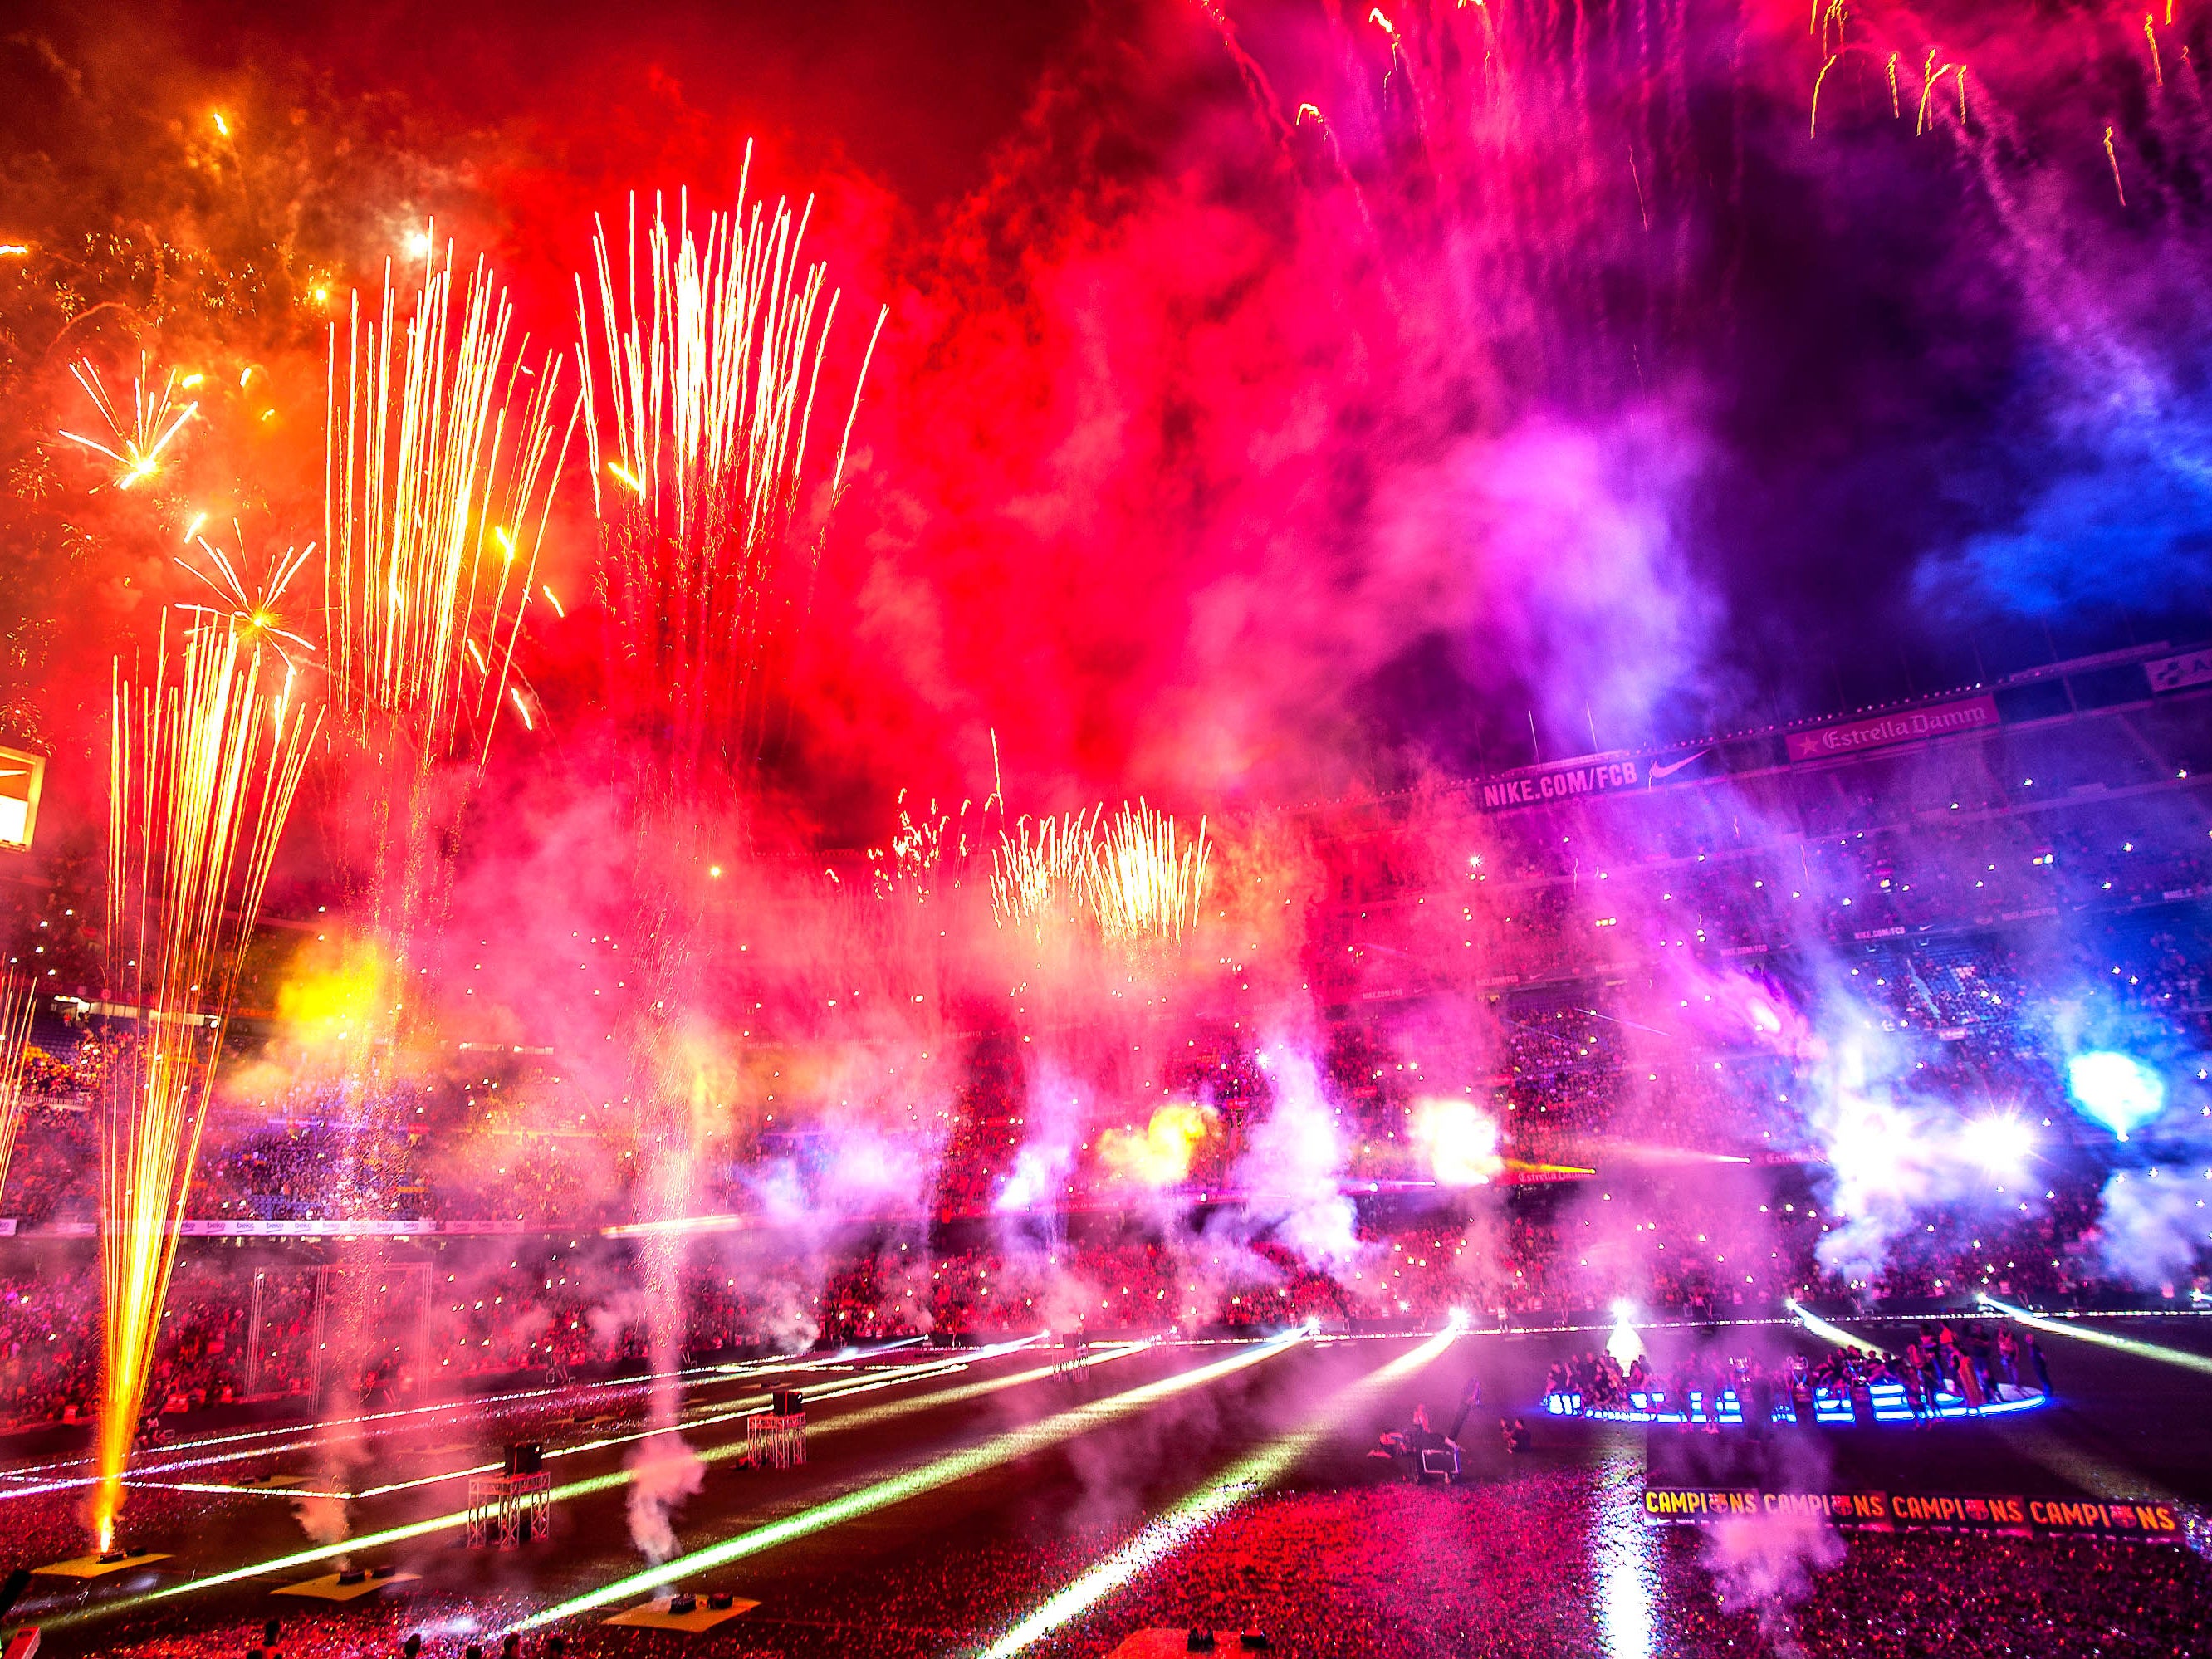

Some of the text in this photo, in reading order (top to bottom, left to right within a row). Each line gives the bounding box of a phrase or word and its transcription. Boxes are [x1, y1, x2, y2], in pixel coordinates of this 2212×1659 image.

[1822, 706, 1989, 750] Estrella Damm
[1484, 762, 1639, 807] NIKE.COM/FCB
[1518, 1171, 1556, 1182] Estrella
